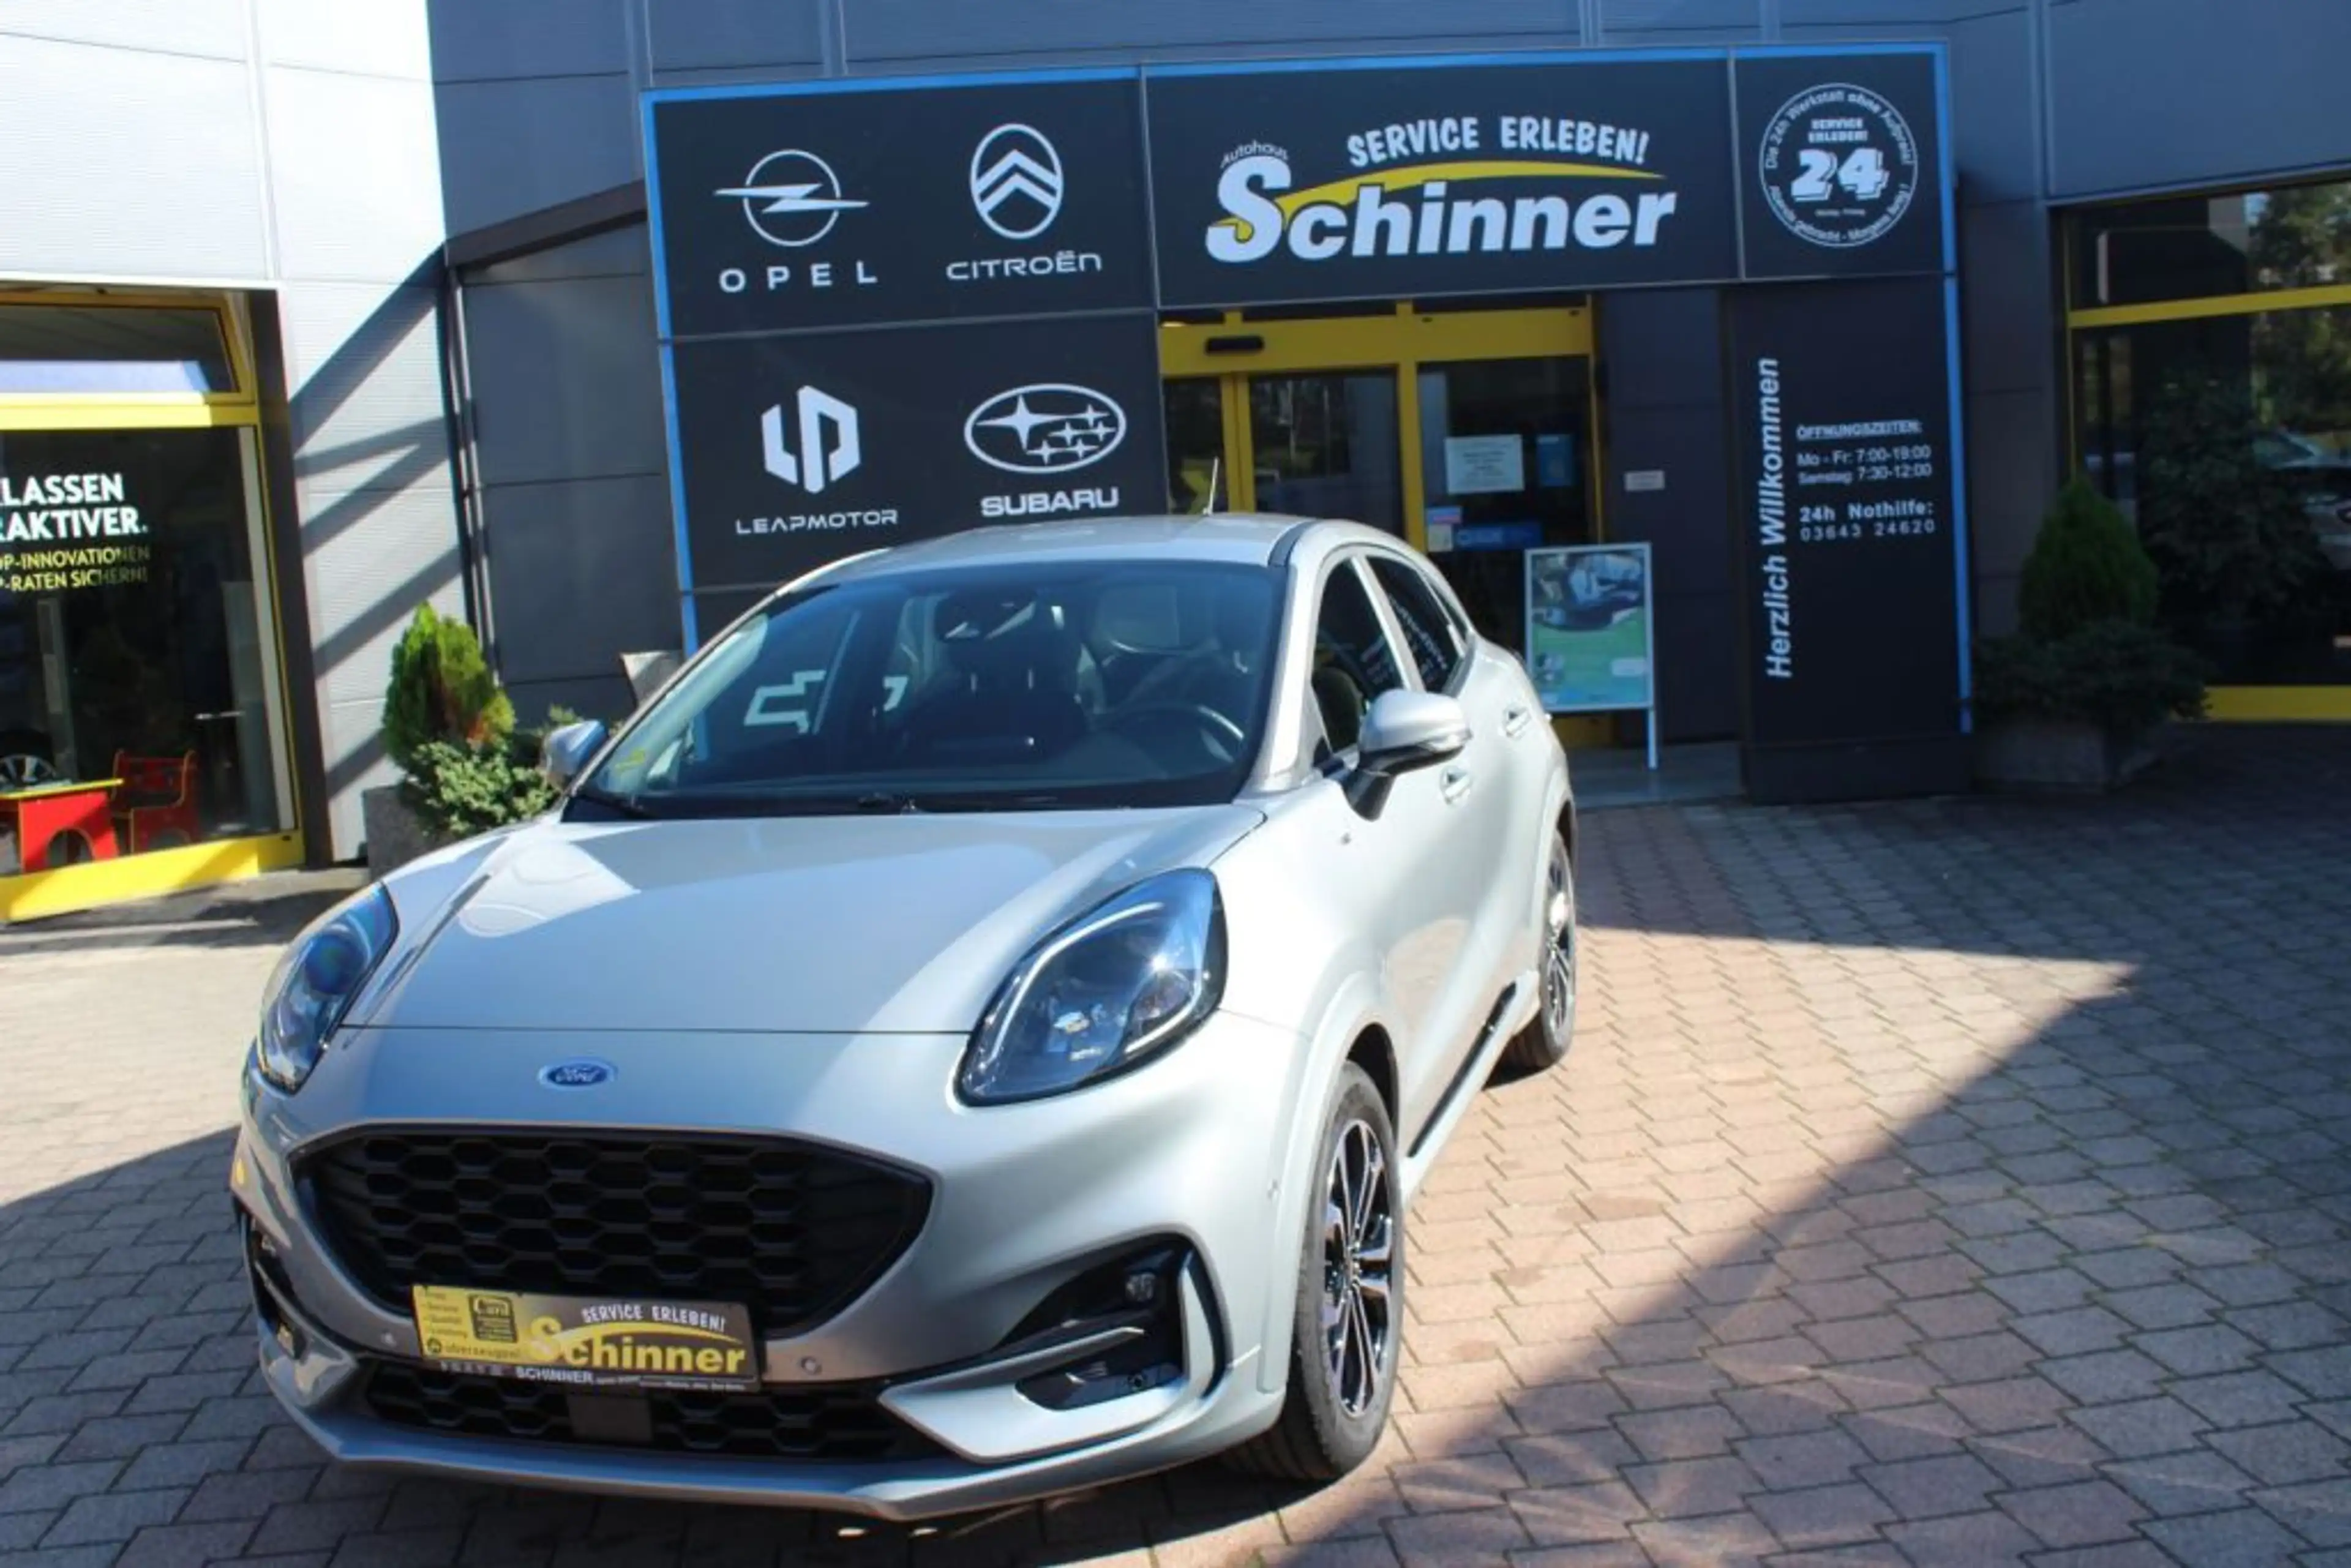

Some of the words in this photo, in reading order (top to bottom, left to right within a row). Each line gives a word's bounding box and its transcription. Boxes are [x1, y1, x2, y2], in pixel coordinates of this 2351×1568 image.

[1348, 117, 1479, 167] SERVICE
[1500, 116, 1649, 164] ERLEBEN!
[1790, 148, 1891, 202] 24
[1205, 156, 1678, 263] Schinner
[719, 261, 878, 293] OPEL
[1758, 357, 1785, 546] Willkommen
[0, 473, 124, 507] LASSEN
[981, 487, 1120, 517] SUBARU
[1800, 505, 1835, 523] 24h
[1848, 498, 1935, 520] Nothilfe:
[736, 509, 898, 535] LEAPMOTOR
[1763, 555, 1792, 678] Herzlich
[582, 1304, 643, 1324] SERVICE
[651, 1305, 726, 1332] ERLEBEN!
[530, 1317, 746, 1374] Schinner
